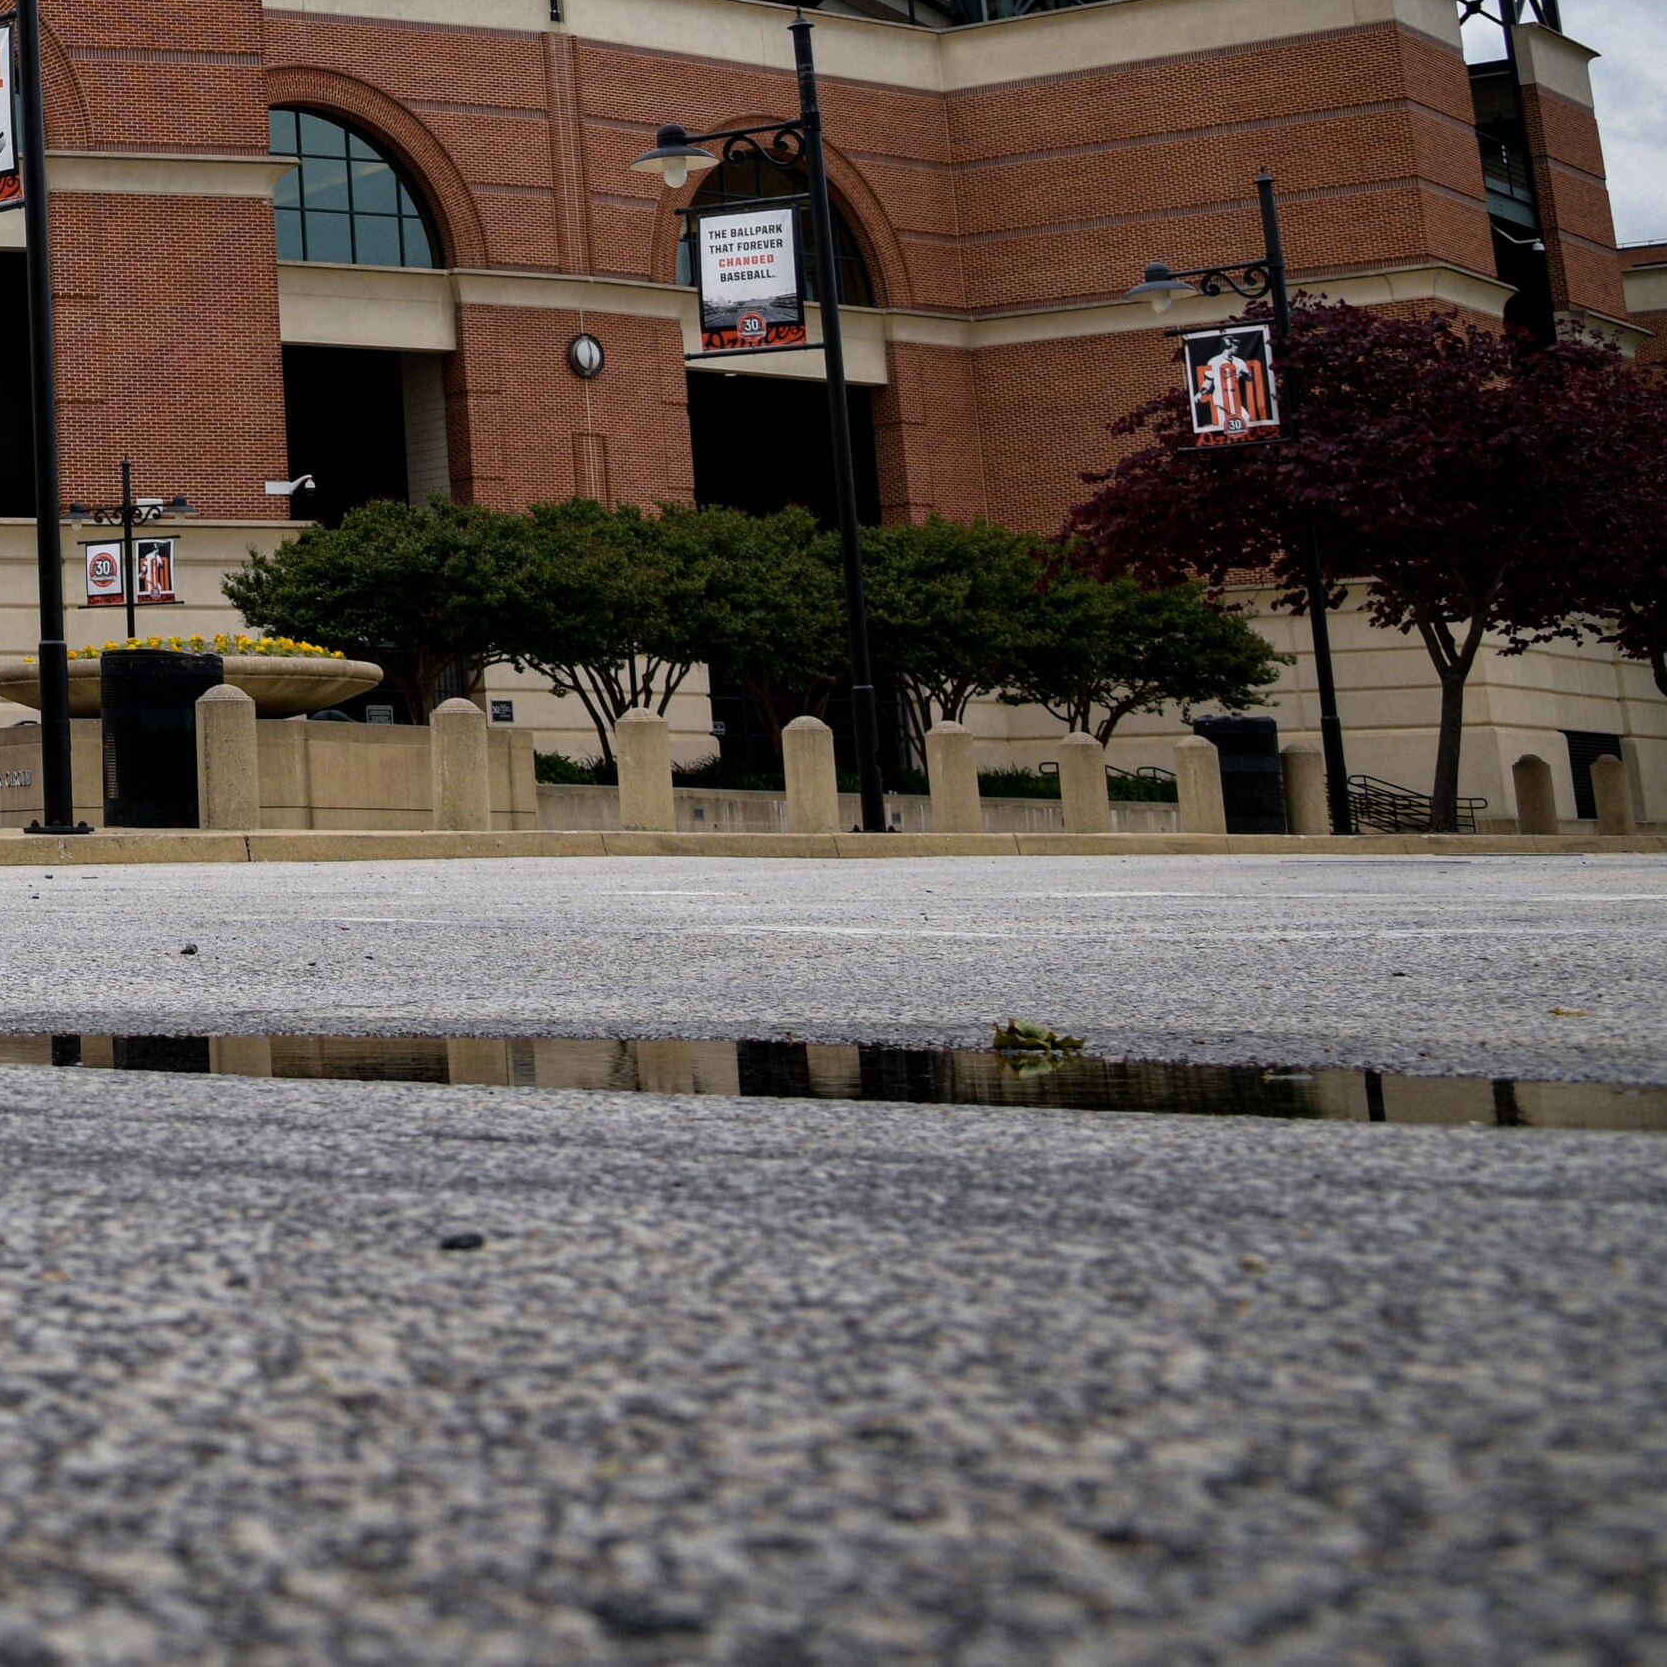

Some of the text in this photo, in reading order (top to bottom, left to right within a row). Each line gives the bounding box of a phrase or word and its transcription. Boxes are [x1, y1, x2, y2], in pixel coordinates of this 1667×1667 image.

[708, 224, 783, 240] THE BALLPARK
[709, 238, 783, 254] THAT FOREVER
[719, 254, 774, 268] CHANGED
[744, 318, 759, 331] 30
[1229, 419, 1241, 430] 30
[95, 560, 110, 575] 30
